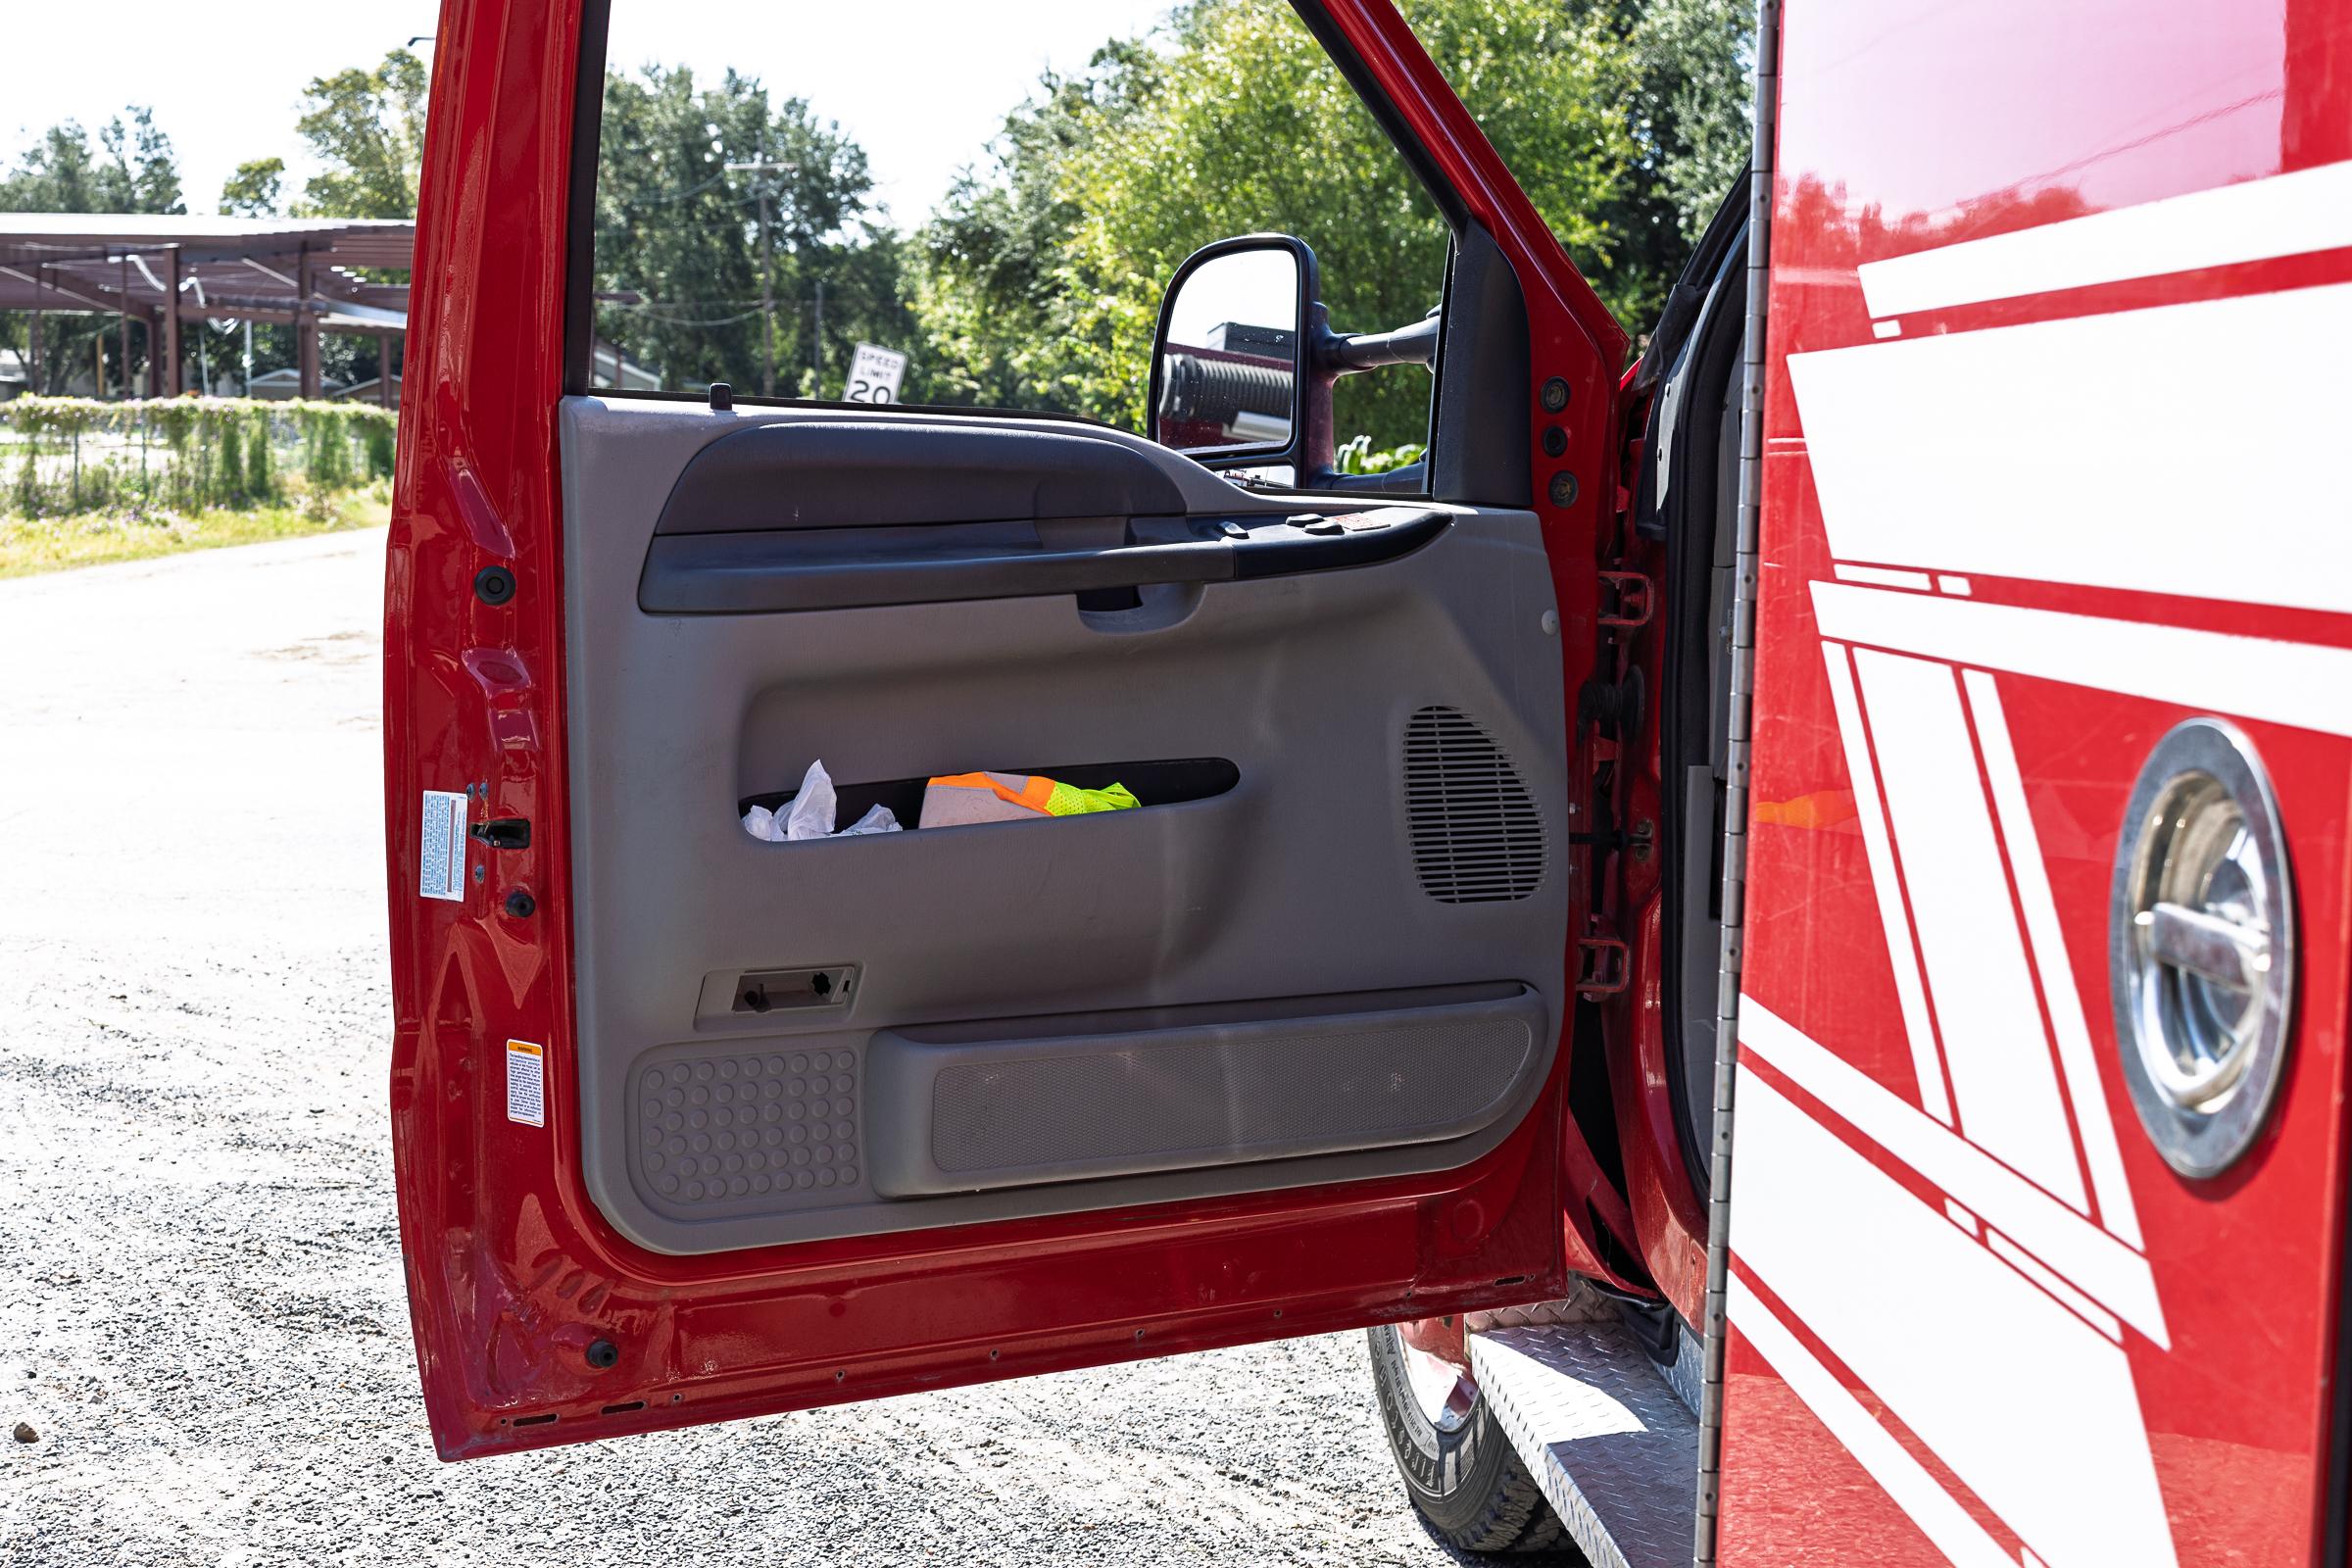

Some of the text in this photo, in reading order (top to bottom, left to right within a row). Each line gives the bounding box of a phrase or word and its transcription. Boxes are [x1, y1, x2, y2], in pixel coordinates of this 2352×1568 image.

[861, 352, 899, 368] SPEED
[859, 366, 892, 380] LIMIT
[850, 380, 891, 404] 20
